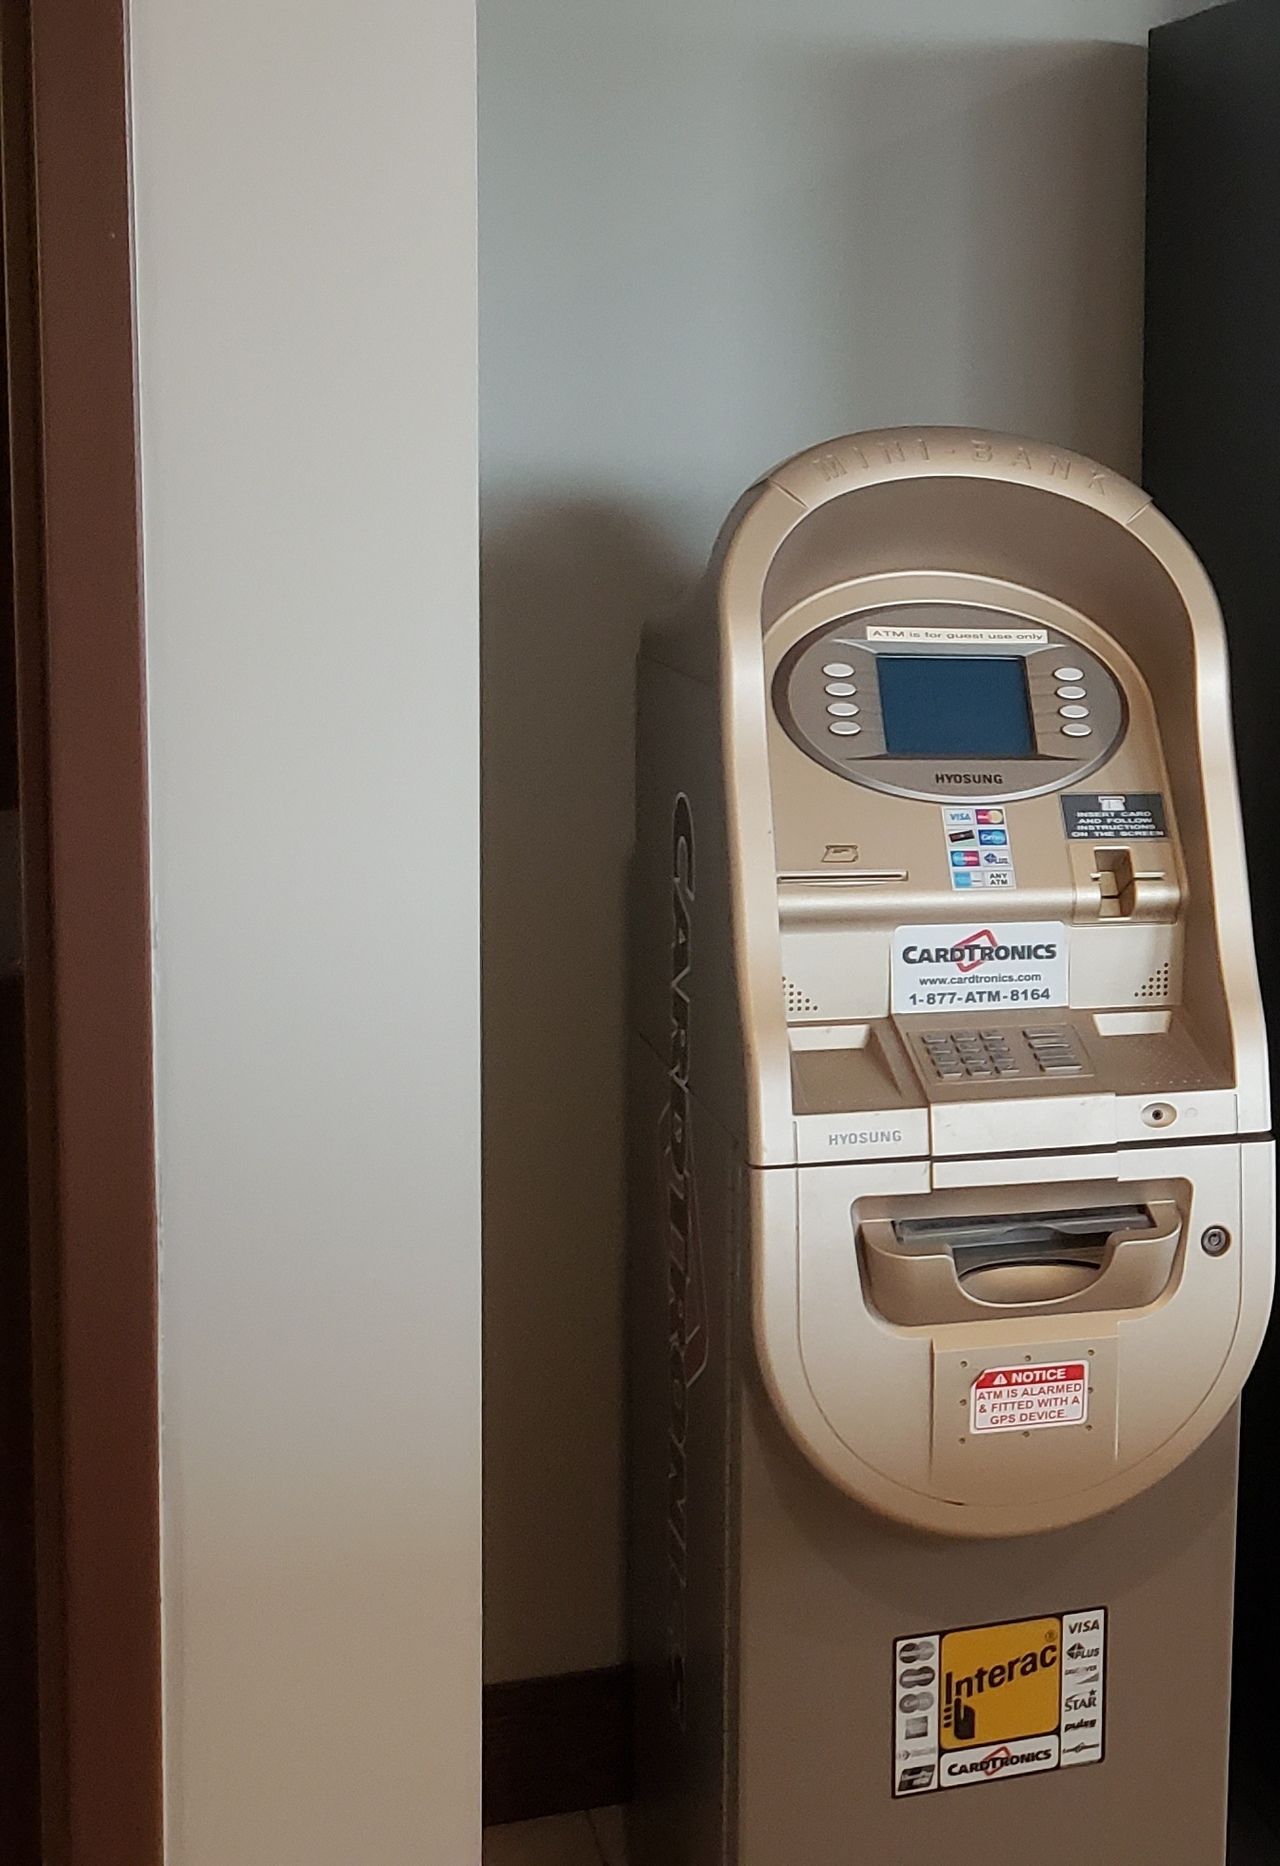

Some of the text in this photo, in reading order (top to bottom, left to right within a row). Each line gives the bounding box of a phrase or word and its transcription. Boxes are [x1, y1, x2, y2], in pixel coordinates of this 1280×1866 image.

[873, 629, 1043, 641] ATM is for guest use only
[935, 773, 1004, 785] HYOSUNG
[949, 813, 971, 821] VISA
[902, 943, 1057, 965] CARDTRONICS
[918, 972, 1042, 986] www.cardtronics.com
[908, 988, 1050, 1006] 1-877-ATM-8164
[828, 1130, 902, 1146] HYOSUNG
[1011, 1368, 1067, 1384] NOTICE
[978, 1383, 1082, 1401] ATM IS ALARMED
[979, 1395, 1080, 1413] & FITTED WITH A
[990, 1413, 1016, 1425] GPS
[1068, 1619, 1100, 1635] VISA
[1075, 1647, 1100, 1659] PLUS
[945, 1643, 1057, 1705] Interac
[1064, 1696, 1097, 1713] STAR
[947, 1748, 1052, 1776] CARDTRONICS
